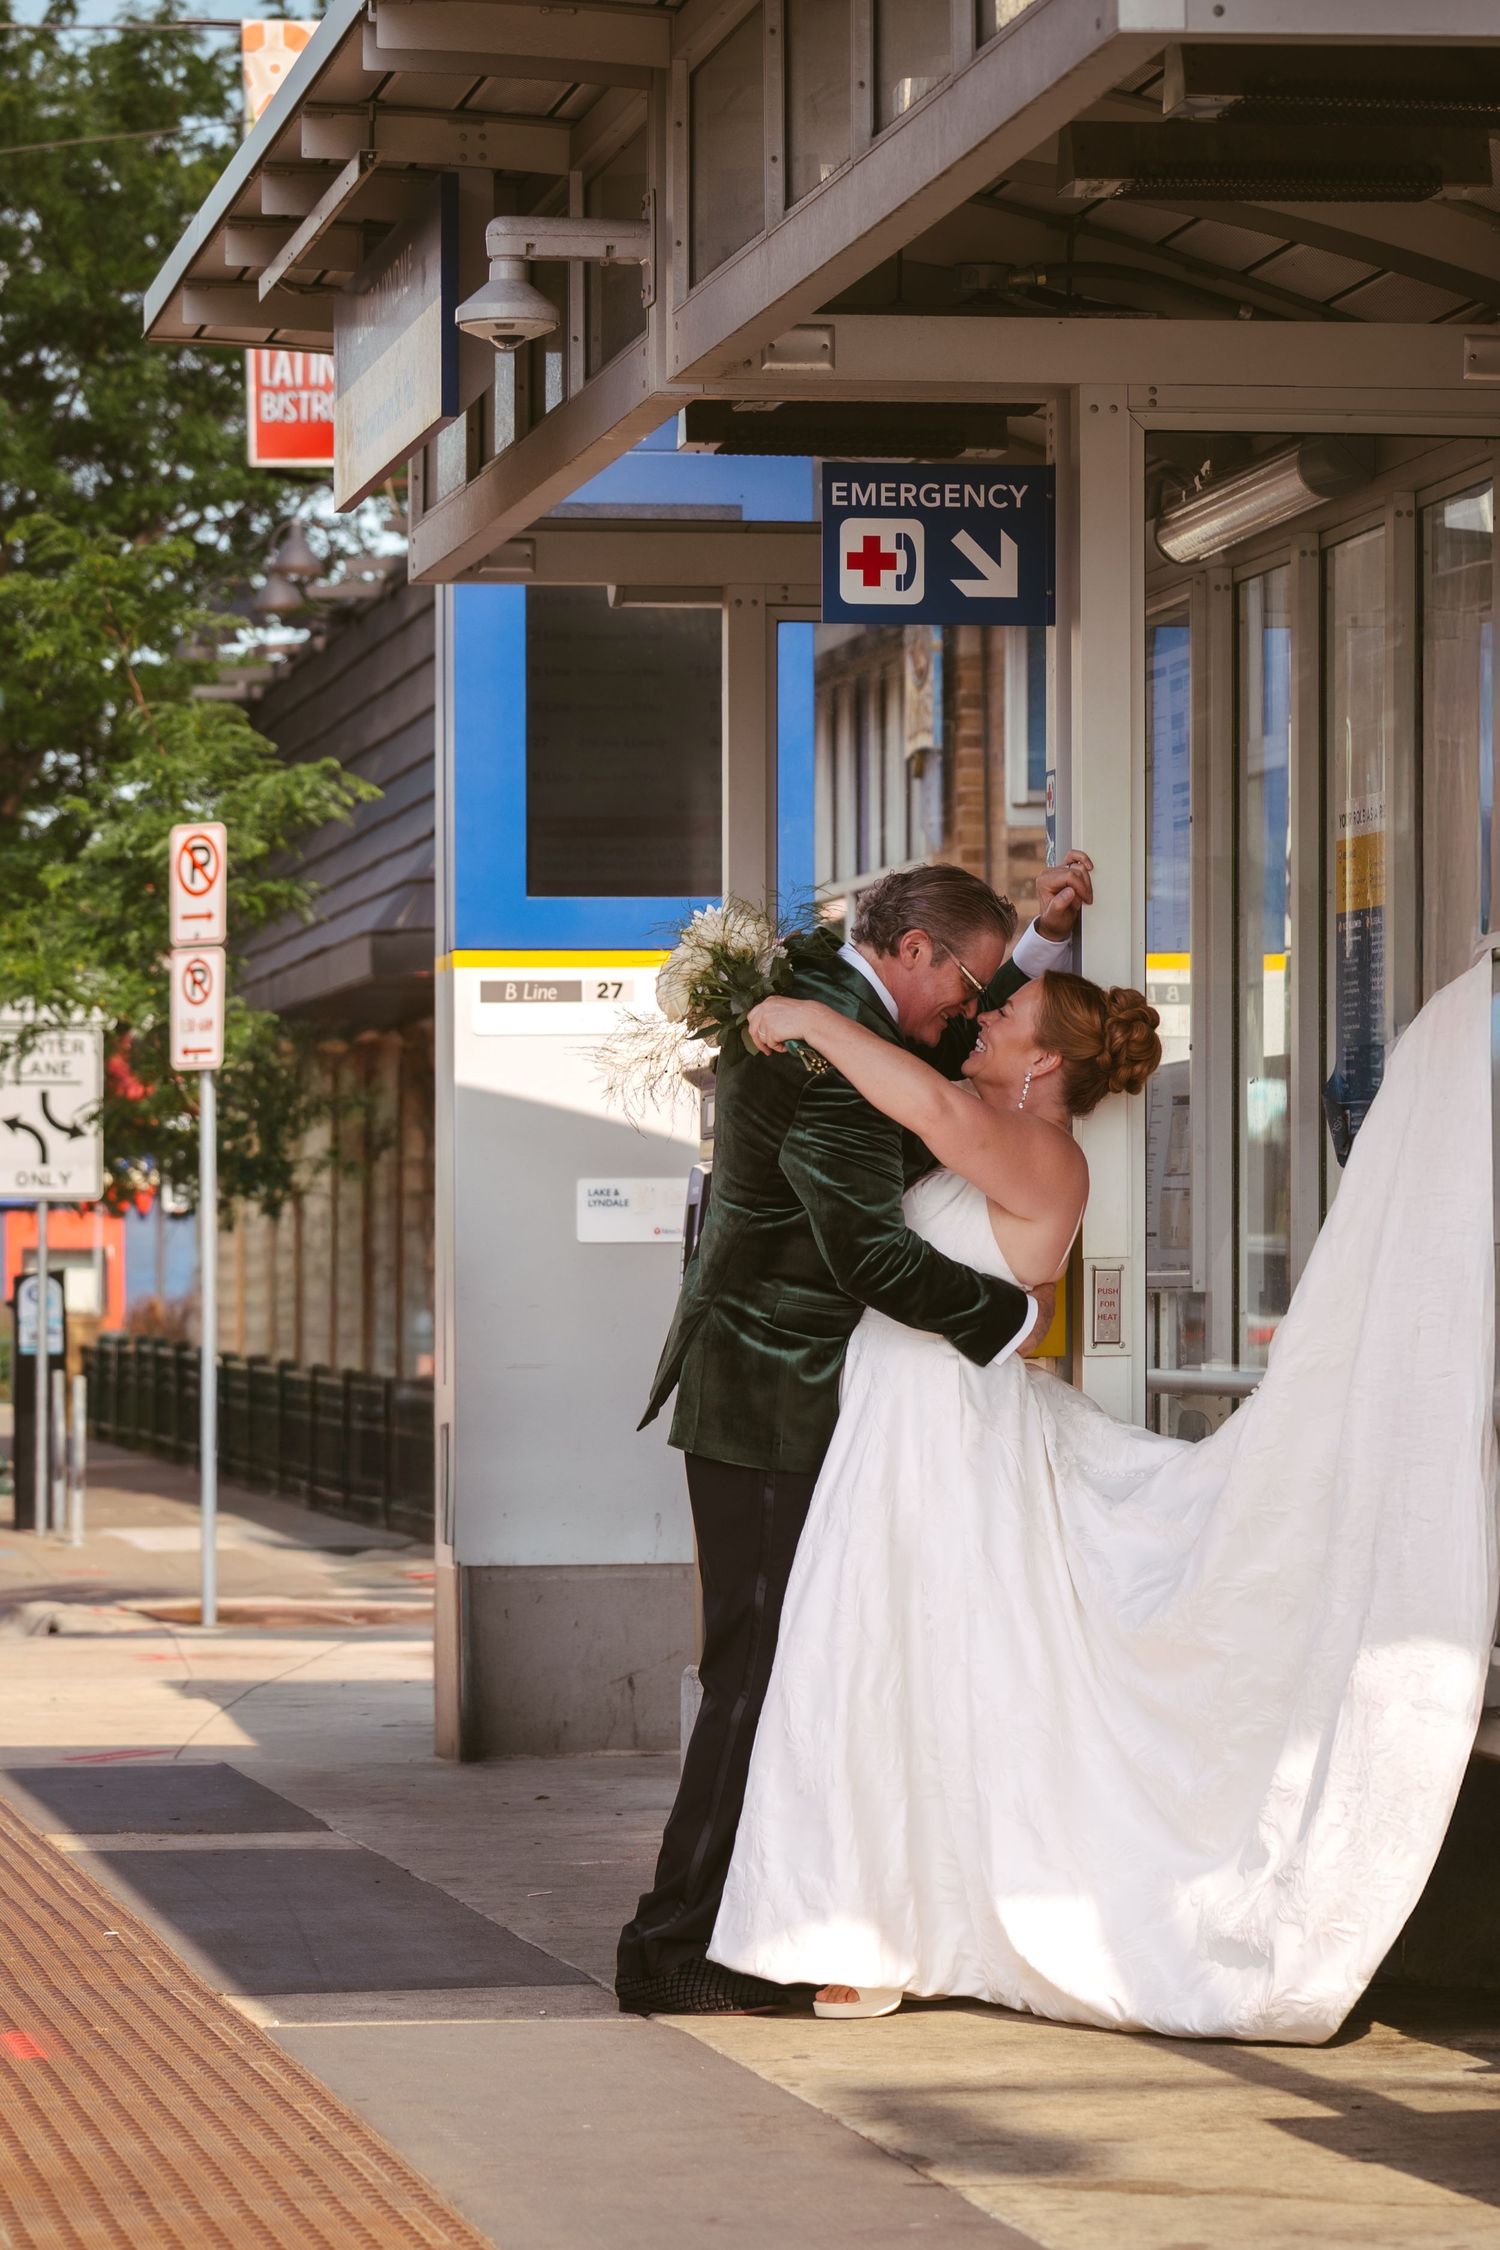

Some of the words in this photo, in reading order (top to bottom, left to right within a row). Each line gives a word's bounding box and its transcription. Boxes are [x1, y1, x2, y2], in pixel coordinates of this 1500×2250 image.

[831, 481, 1029, 509] EMERGENCY
[505, 983, 517, 1000] B
[523, 983, 558, 1000] Line
[597, 983, 623, 999] 27
[31, 1038, 84, 1054] NTER
[15, 1171, 71, 1187] ONLY
[587, 1188, 610, 1197] LAKE
[613, 1188, 620, 1197] &
[587, 1199, 630, 1207] LYNDALE
[1100, 1300, 1116, 1308] FOR
[1097, 1313, 1118, 1321] HEAT
